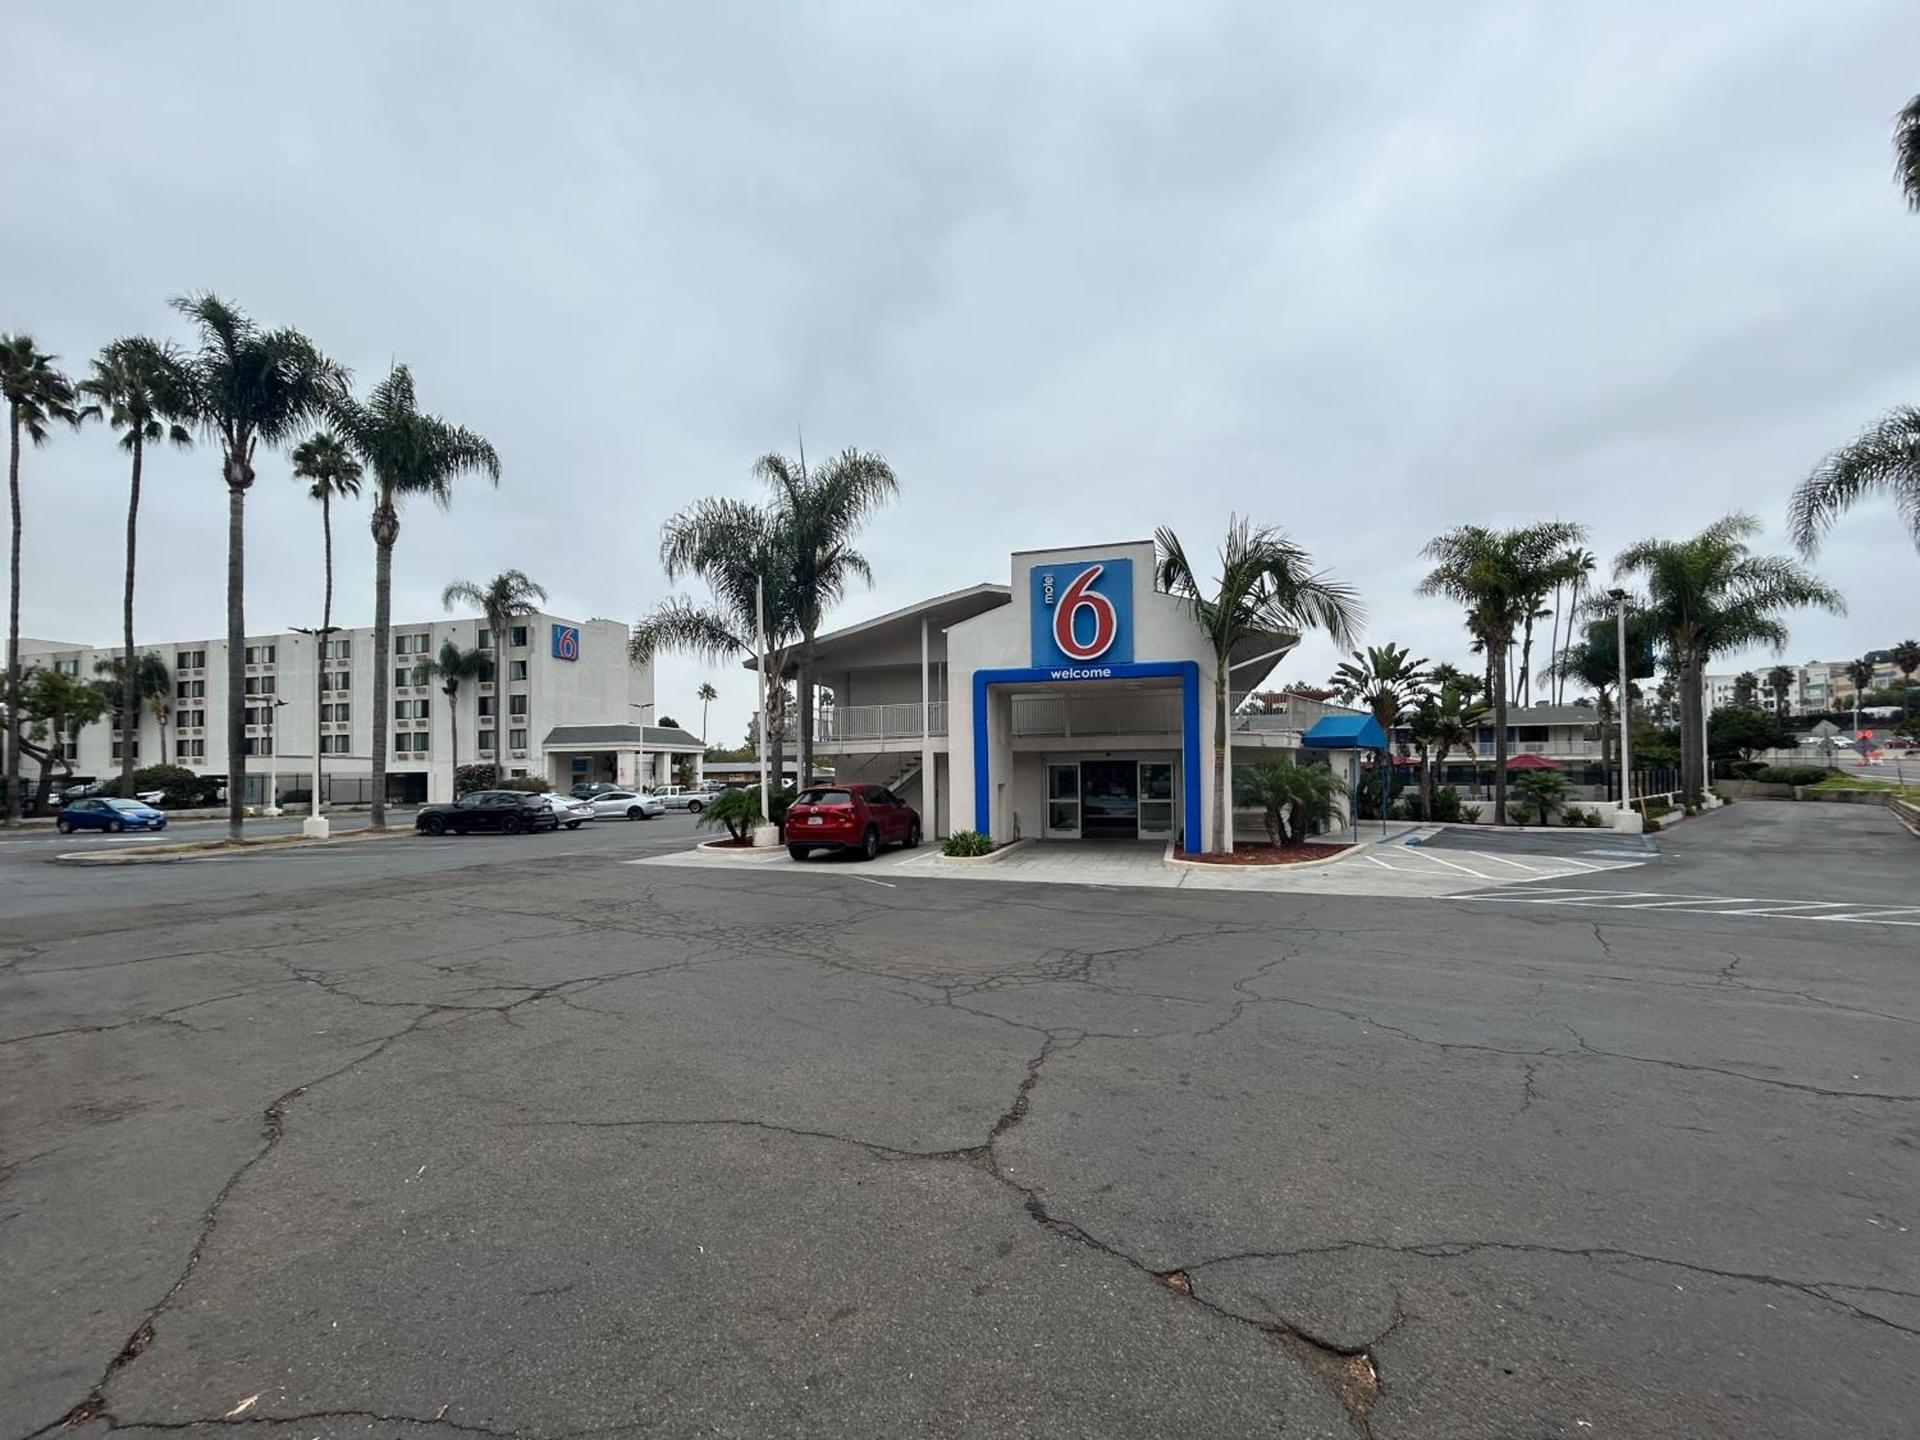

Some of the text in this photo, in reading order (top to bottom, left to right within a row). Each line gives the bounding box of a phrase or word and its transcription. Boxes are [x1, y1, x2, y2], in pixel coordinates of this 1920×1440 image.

[1044, 564, 1117, 660] motel 6
[559, 628, 576, 659] 6
[1051, 668, 1111, 679] welcome
